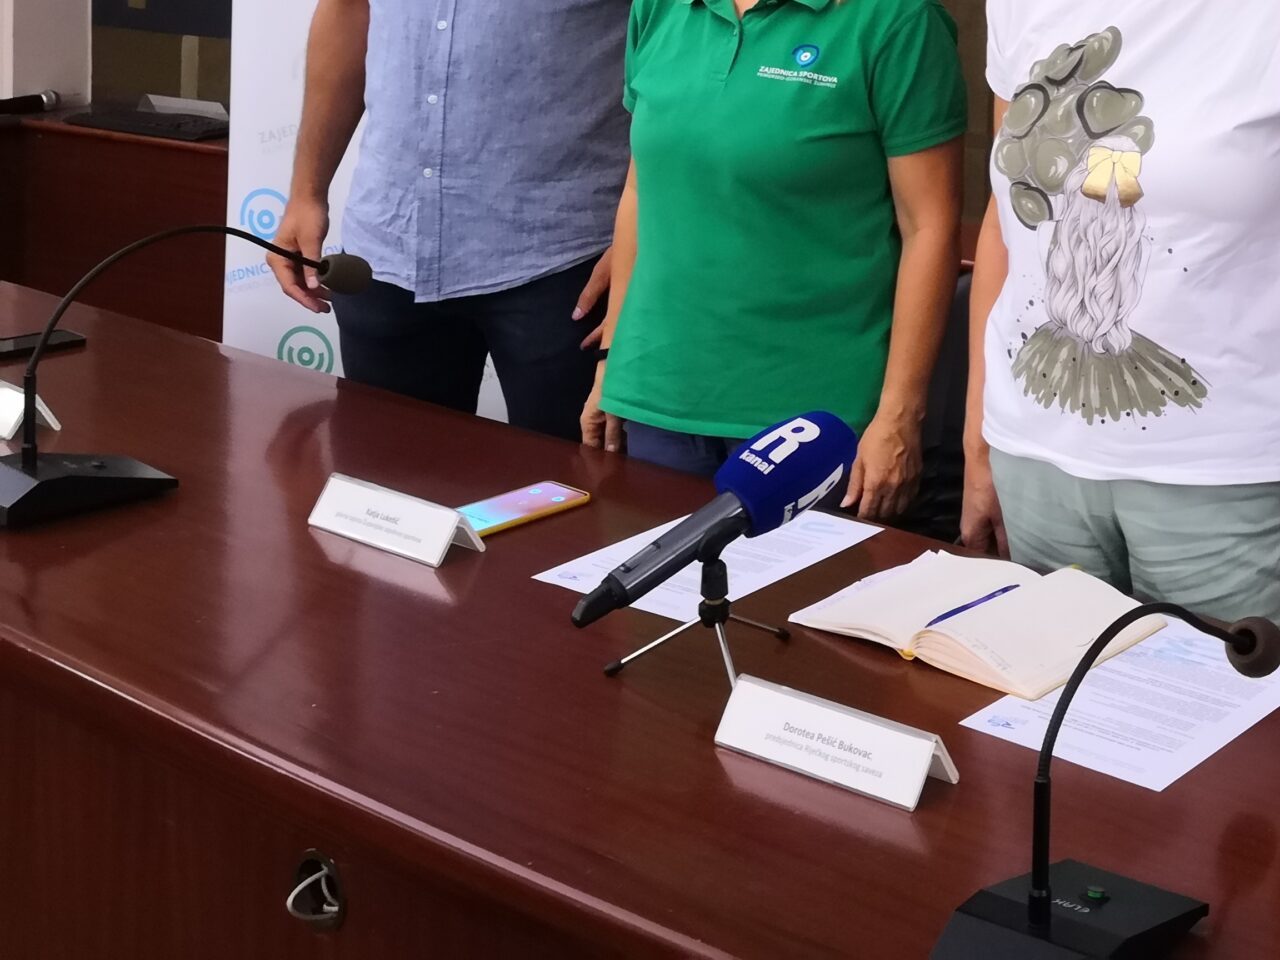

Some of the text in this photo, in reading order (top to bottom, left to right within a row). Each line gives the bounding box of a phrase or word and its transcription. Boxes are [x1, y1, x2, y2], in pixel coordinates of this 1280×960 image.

[759, 66, 838, 83] ZAJEDNICA SPORTOVA
[739, 449, 775, 475] kanal
[783, 721, 815, 741] Dorotea
[816, 732, 838, 749] Pešić
